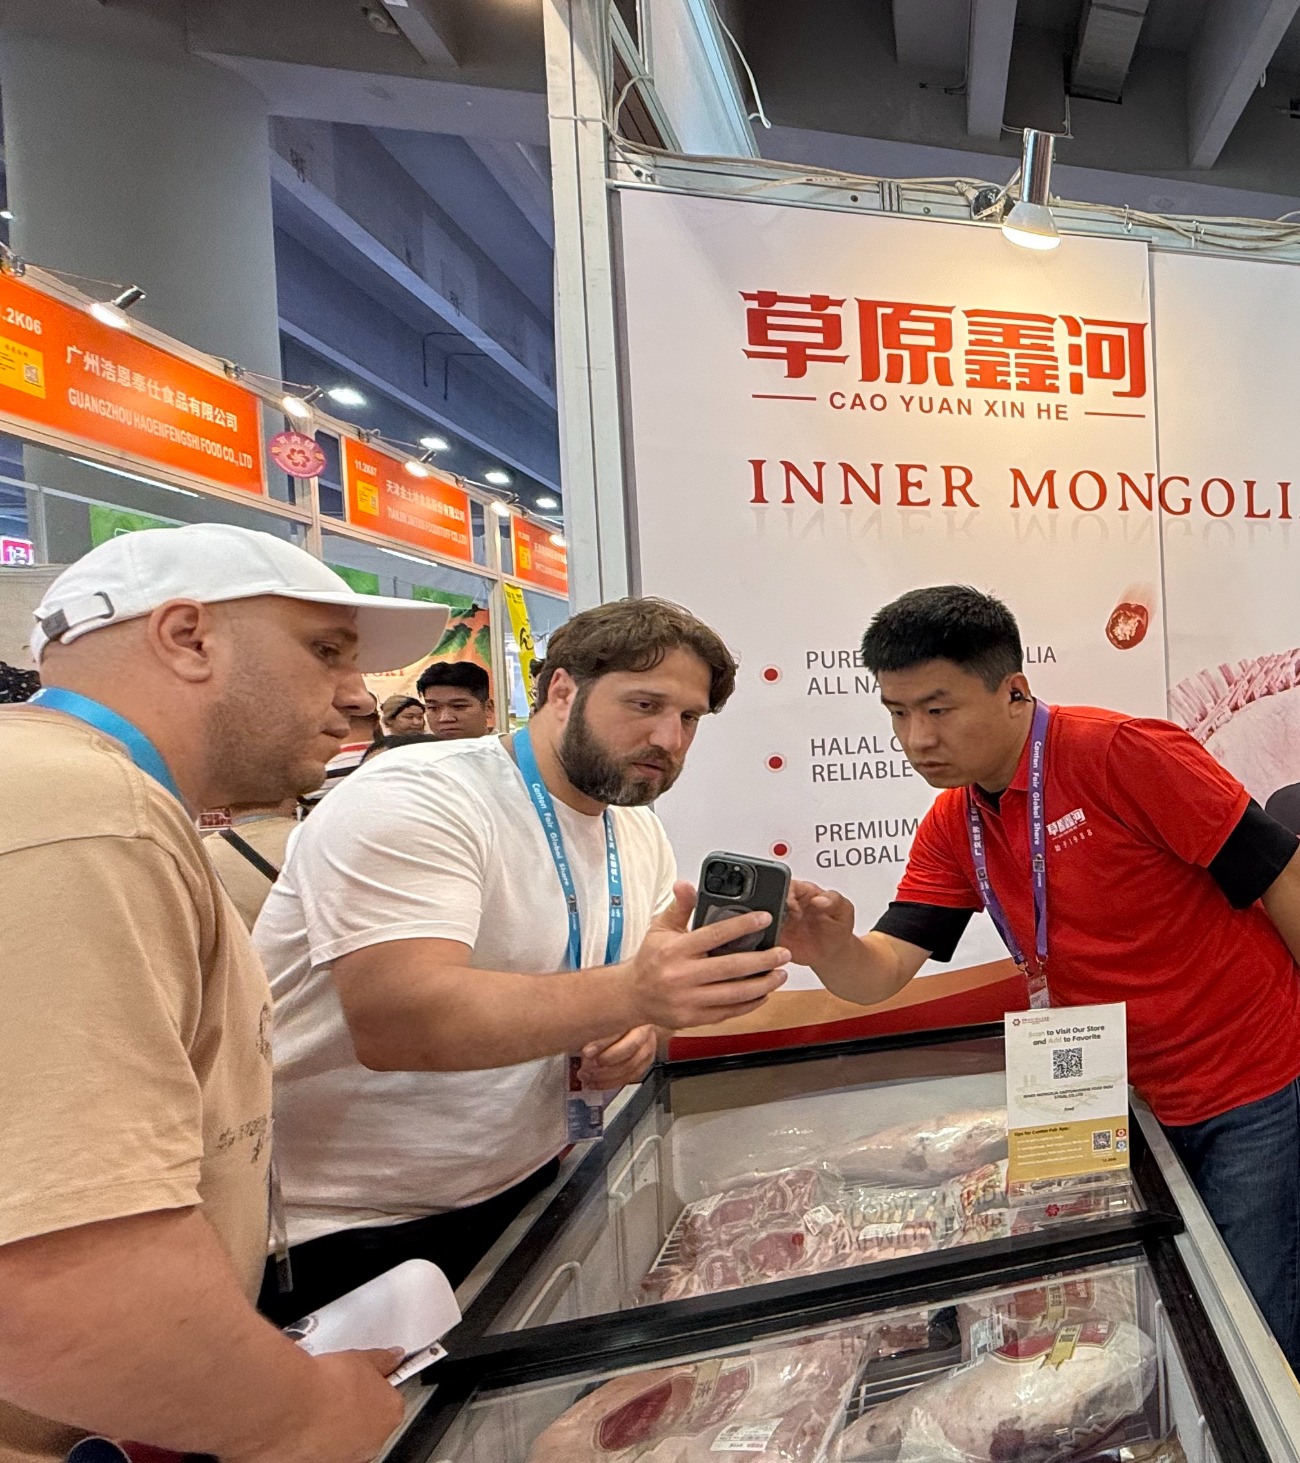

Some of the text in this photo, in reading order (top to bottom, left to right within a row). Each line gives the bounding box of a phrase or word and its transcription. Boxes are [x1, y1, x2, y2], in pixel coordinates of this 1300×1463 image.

[739, 290, 1149, 399] 草原鑫河
[829, 391, 1069, 421] CAO YUAN XIN HE
[67, 388, 134, 426] GUANGZHOU
[200, 438, 222, 459] FOOD
[747, 459, 980, 508] INNER
[807, 649, 864, 669] PURE
[807, 676, 848, 695] ALL
[810, 736, 884, 756] HALAL
[1033, 741, 1042, 769] Canton
[812, 760, 914, 782] RELIABLE
[1032, 792, 1041, 819] Global
[532, 783, 570, 887] Canton Fair Global Share
[815, 818, 919, 843] PREMIUM
[1033, 822, 1041, 846] Share
[816, 845, 905, 869] GLOBAL
[1072, 1034, 1101, 1042] Favorite
